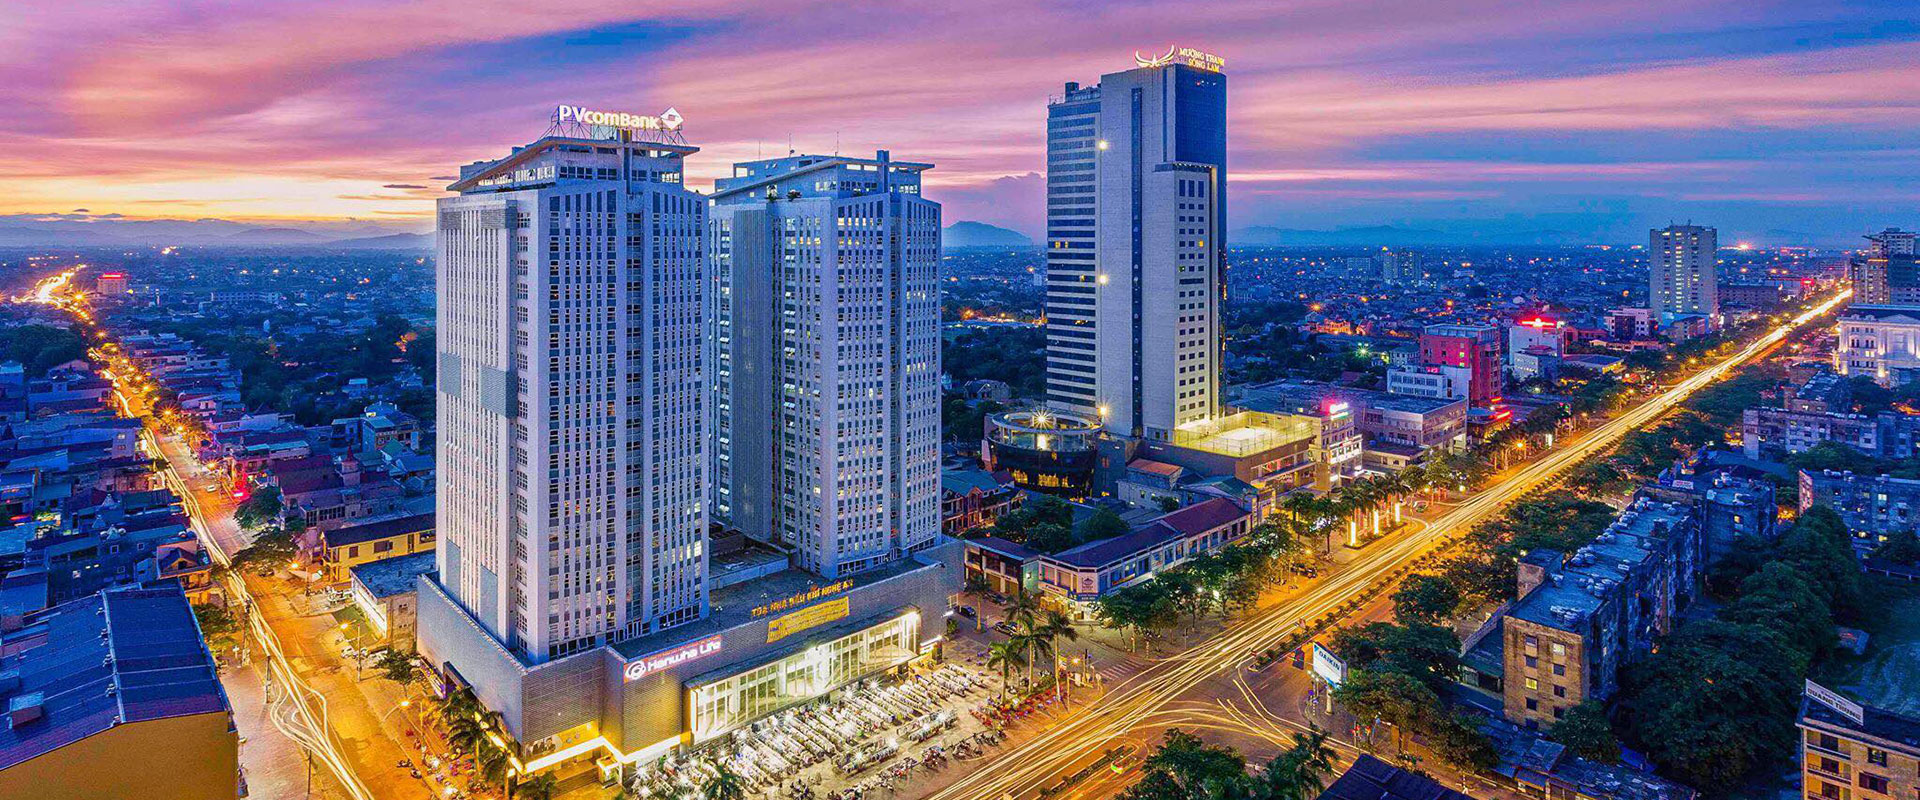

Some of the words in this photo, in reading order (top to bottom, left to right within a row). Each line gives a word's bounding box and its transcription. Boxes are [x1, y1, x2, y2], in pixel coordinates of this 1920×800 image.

[648, 648, 697, 671] Hanwha
[700, 641, 720, 653] Life
[1319, 651, 1340, 670] DAIKIN
